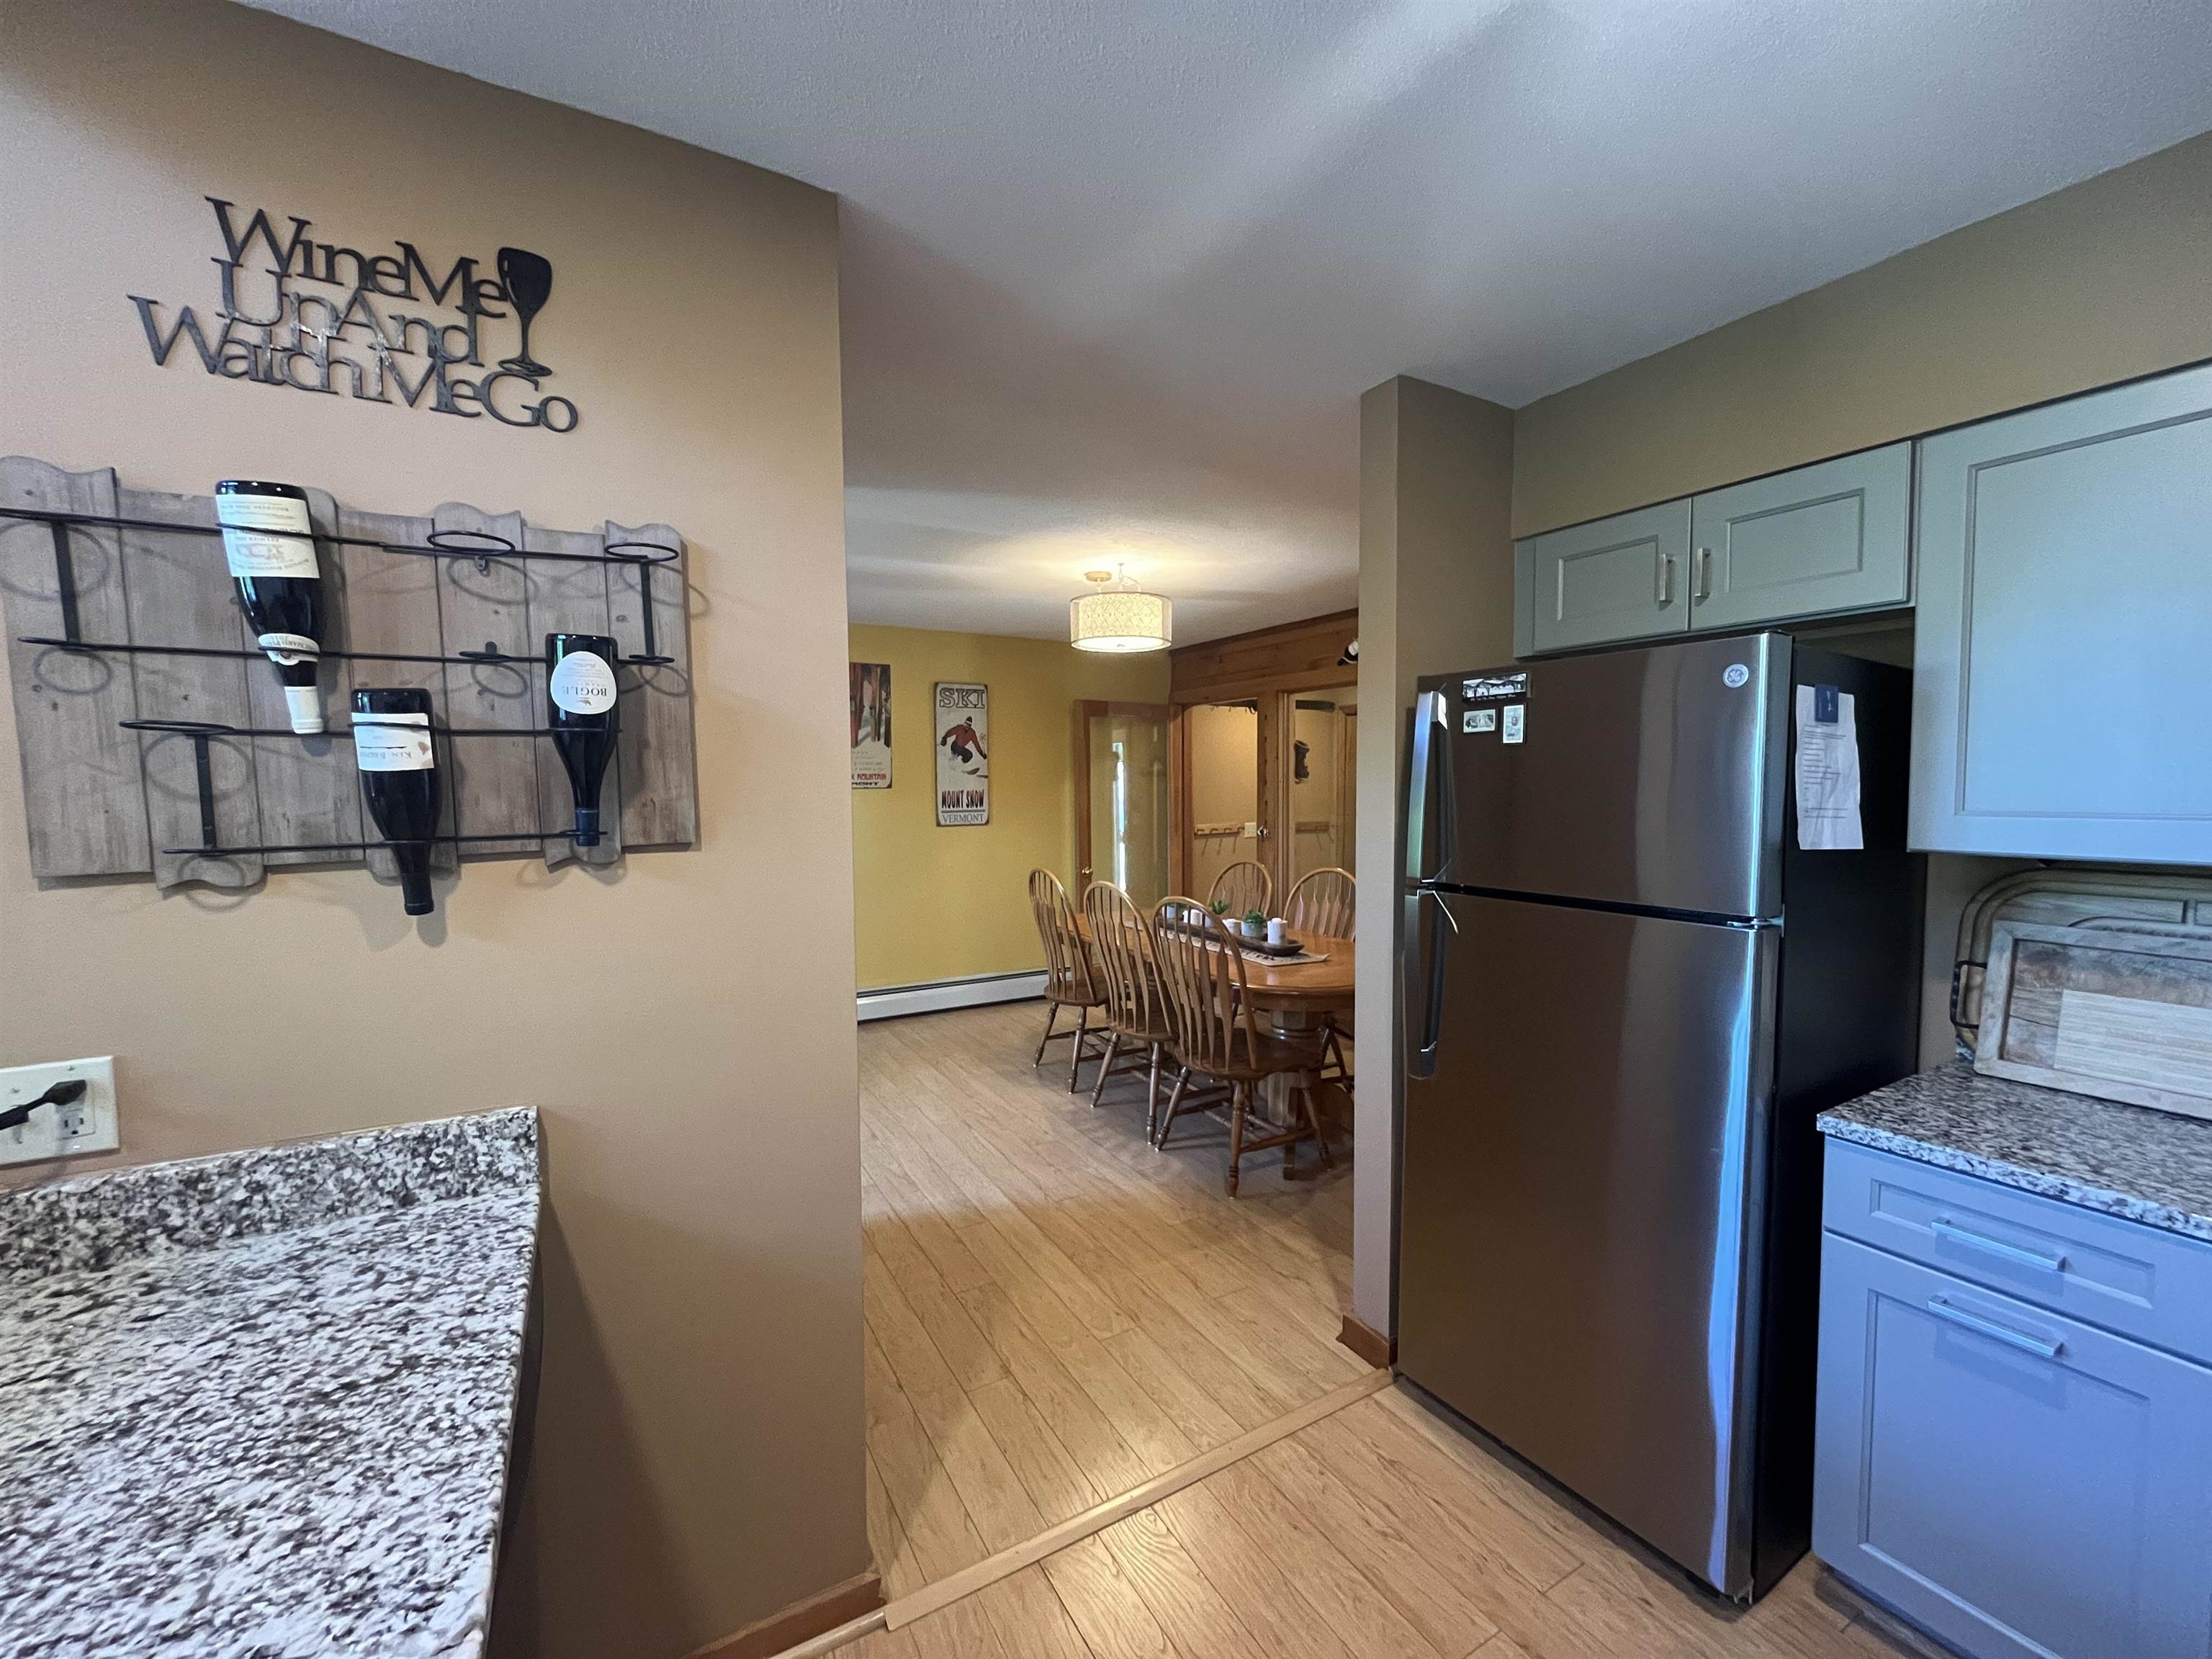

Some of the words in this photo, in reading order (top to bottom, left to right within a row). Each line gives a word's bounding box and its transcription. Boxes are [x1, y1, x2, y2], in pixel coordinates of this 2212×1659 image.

[939, 688, 985, 709] SKI
[941, 791, 964, 809] MOUNT
[966, 789, 985, 809] SNOW
[942, 814, 984, 824] VERMONT
